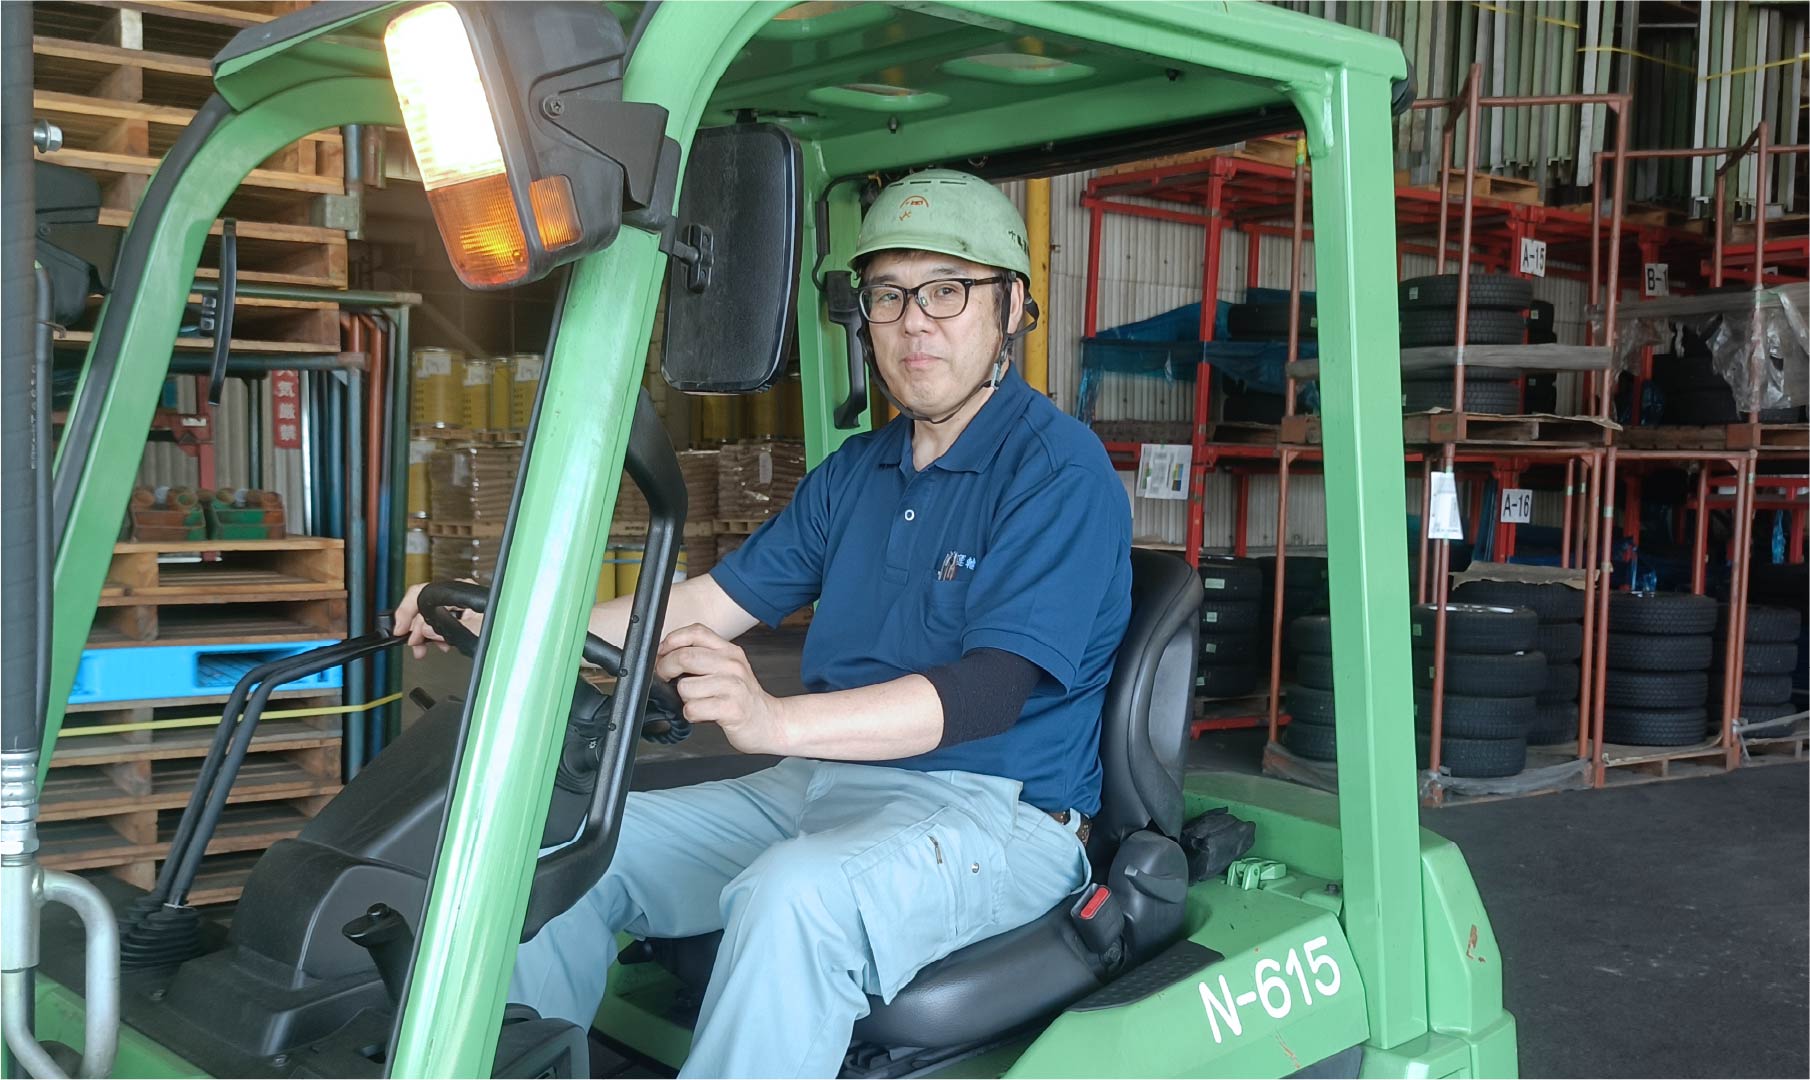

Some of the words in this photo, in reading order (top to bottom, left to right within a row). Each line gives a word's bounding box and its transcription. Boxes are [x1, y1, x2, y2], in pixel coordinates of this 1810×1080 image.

[1522, 243, 1545, 272] A-15
[1502, 493, 1530, 518] A-16
[1198, 935, 1341, 1044] N-615
